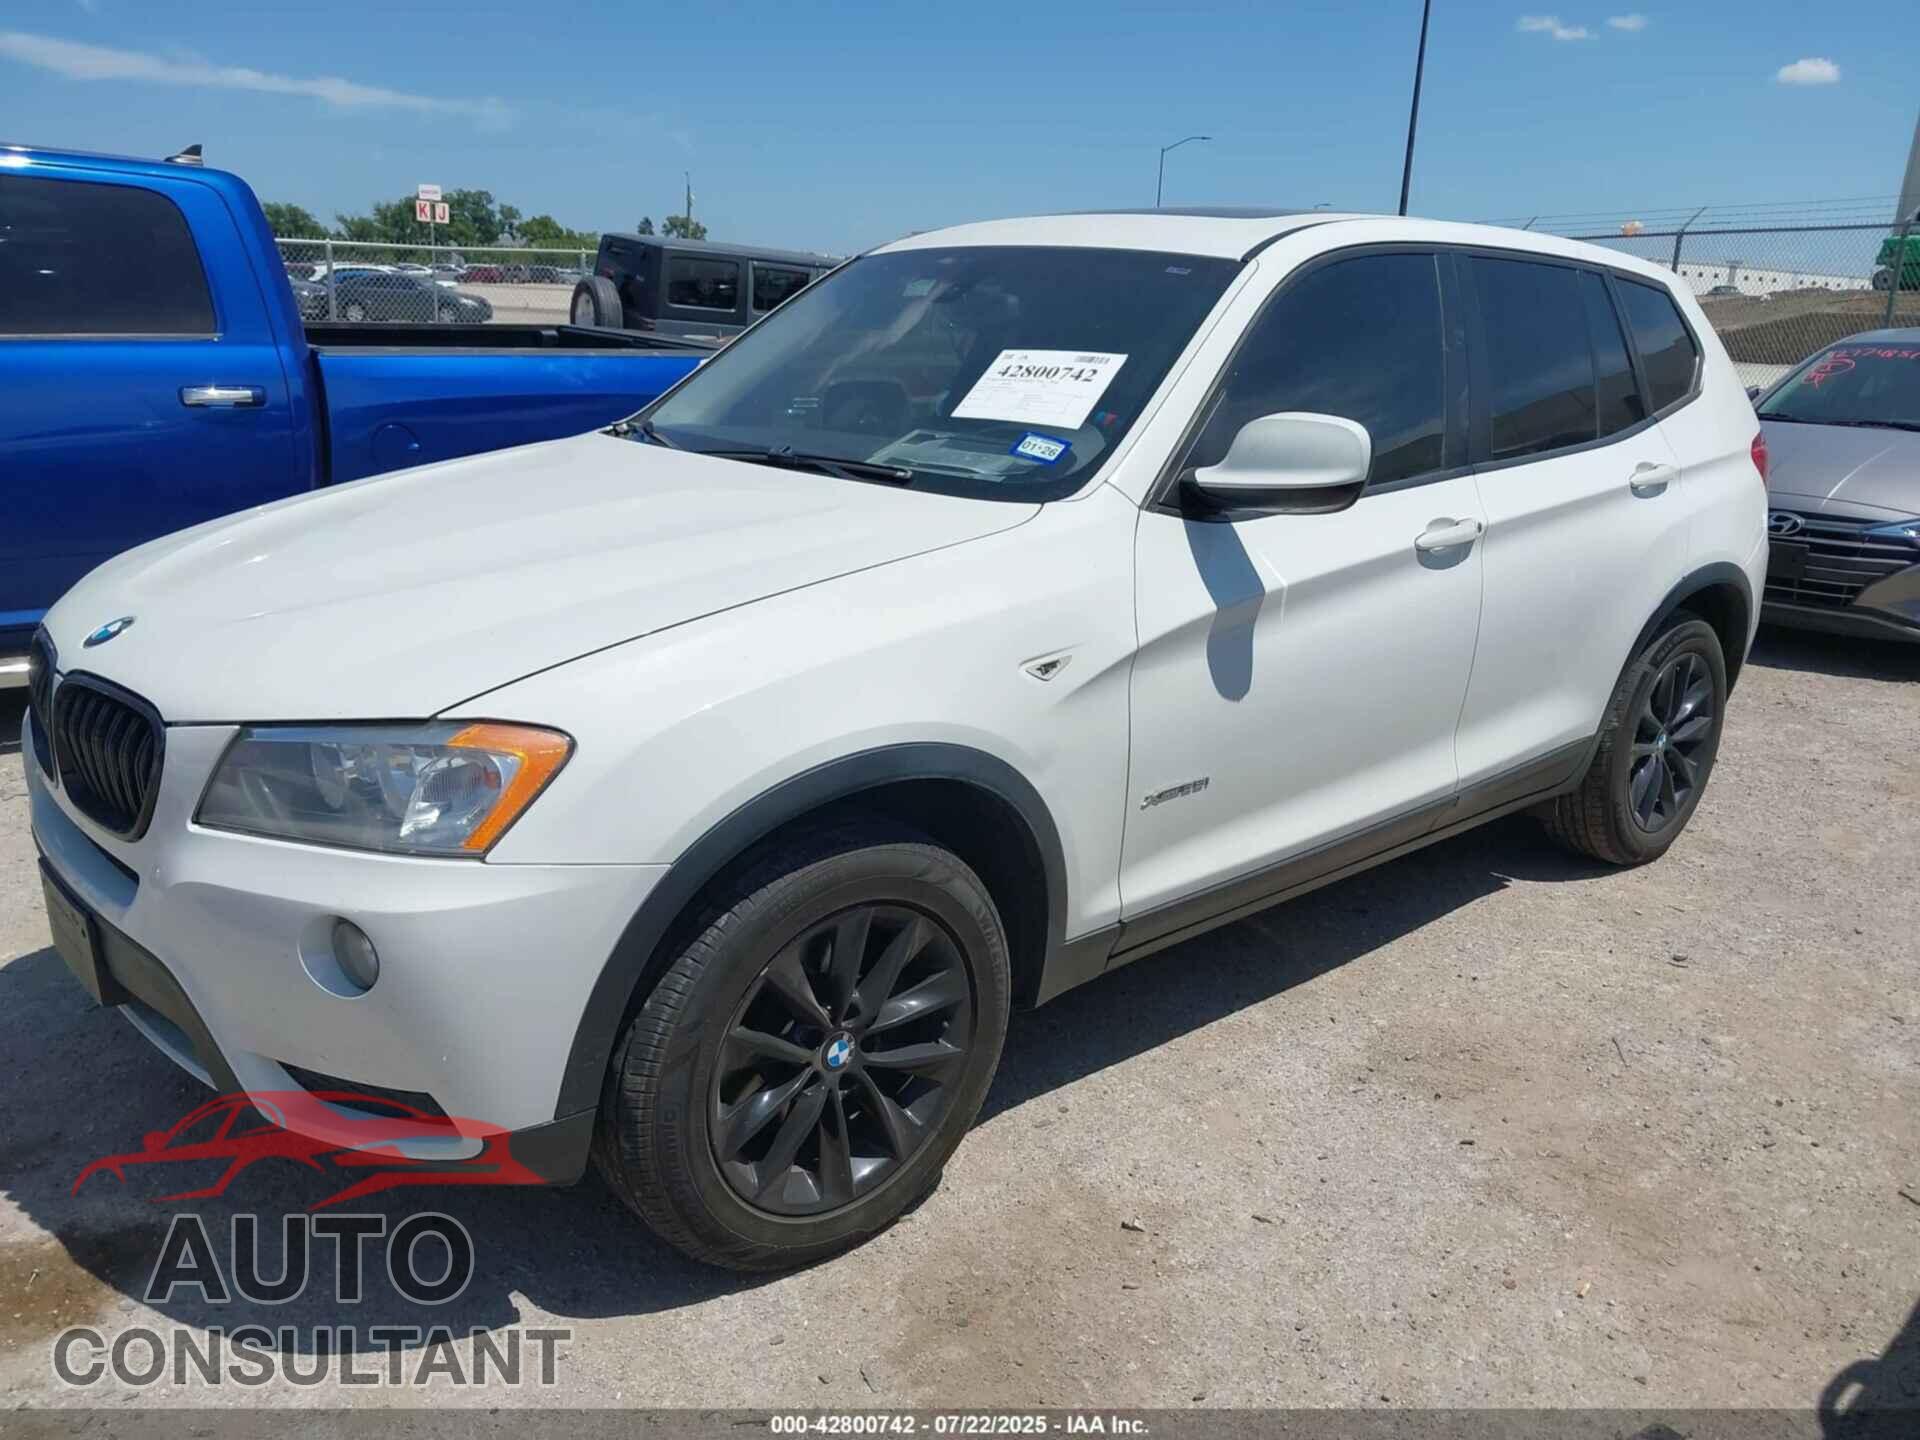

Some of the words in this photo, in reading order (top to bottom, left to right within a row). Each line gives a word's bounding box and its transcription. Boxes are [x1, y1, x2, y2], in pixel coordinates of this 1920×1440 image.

[418, 202, 429, 219] K
[438, 205, 446, 220] J
[998, 365, 1097, 382] 42800742
